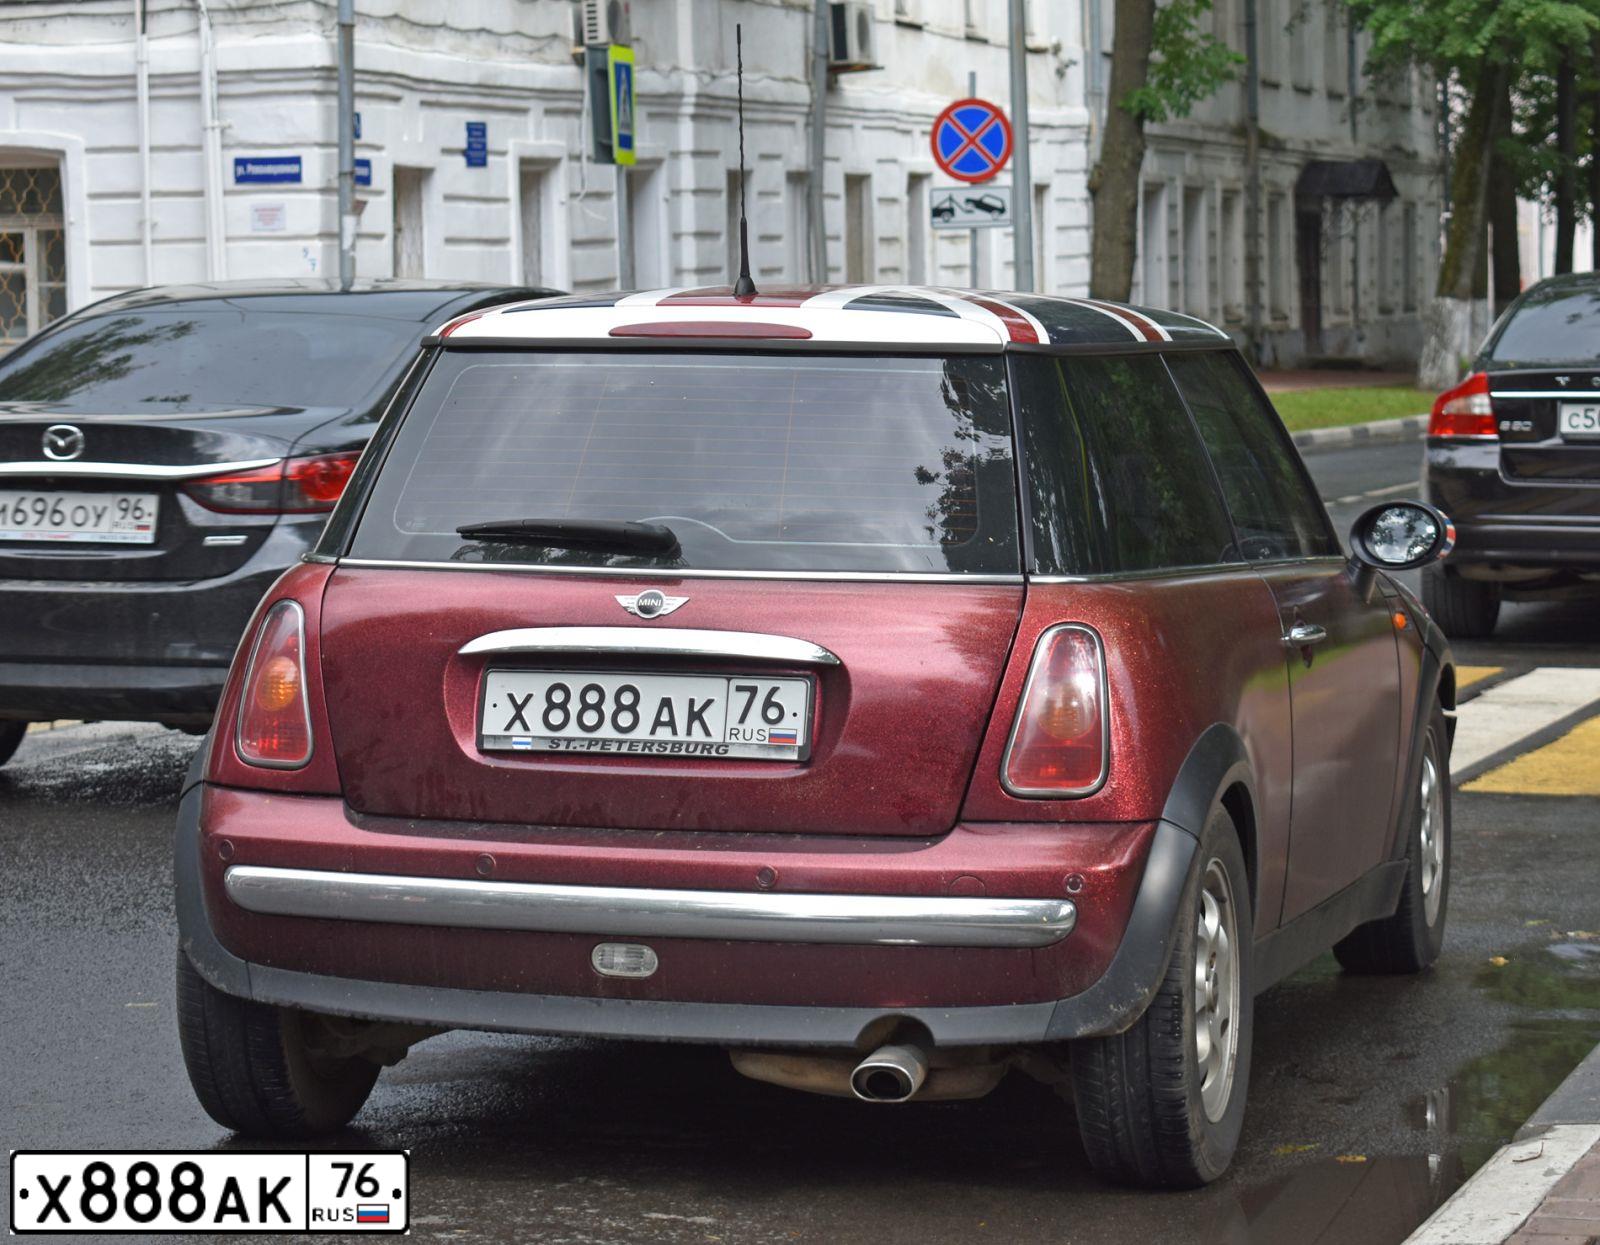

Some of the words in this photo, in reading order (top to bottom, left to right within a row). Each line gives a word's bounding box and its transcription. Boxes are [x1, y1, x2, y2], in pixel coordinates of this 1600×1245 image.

[1568, 408, 1600, 429] C5
[117, 498, 144, 520] 96
[638, 598, 662, 606] MINI
[503, 682, 715, 738] X888AK
[735, 685, 785, 725] 76
[728, 727, 767, 743] RUS
